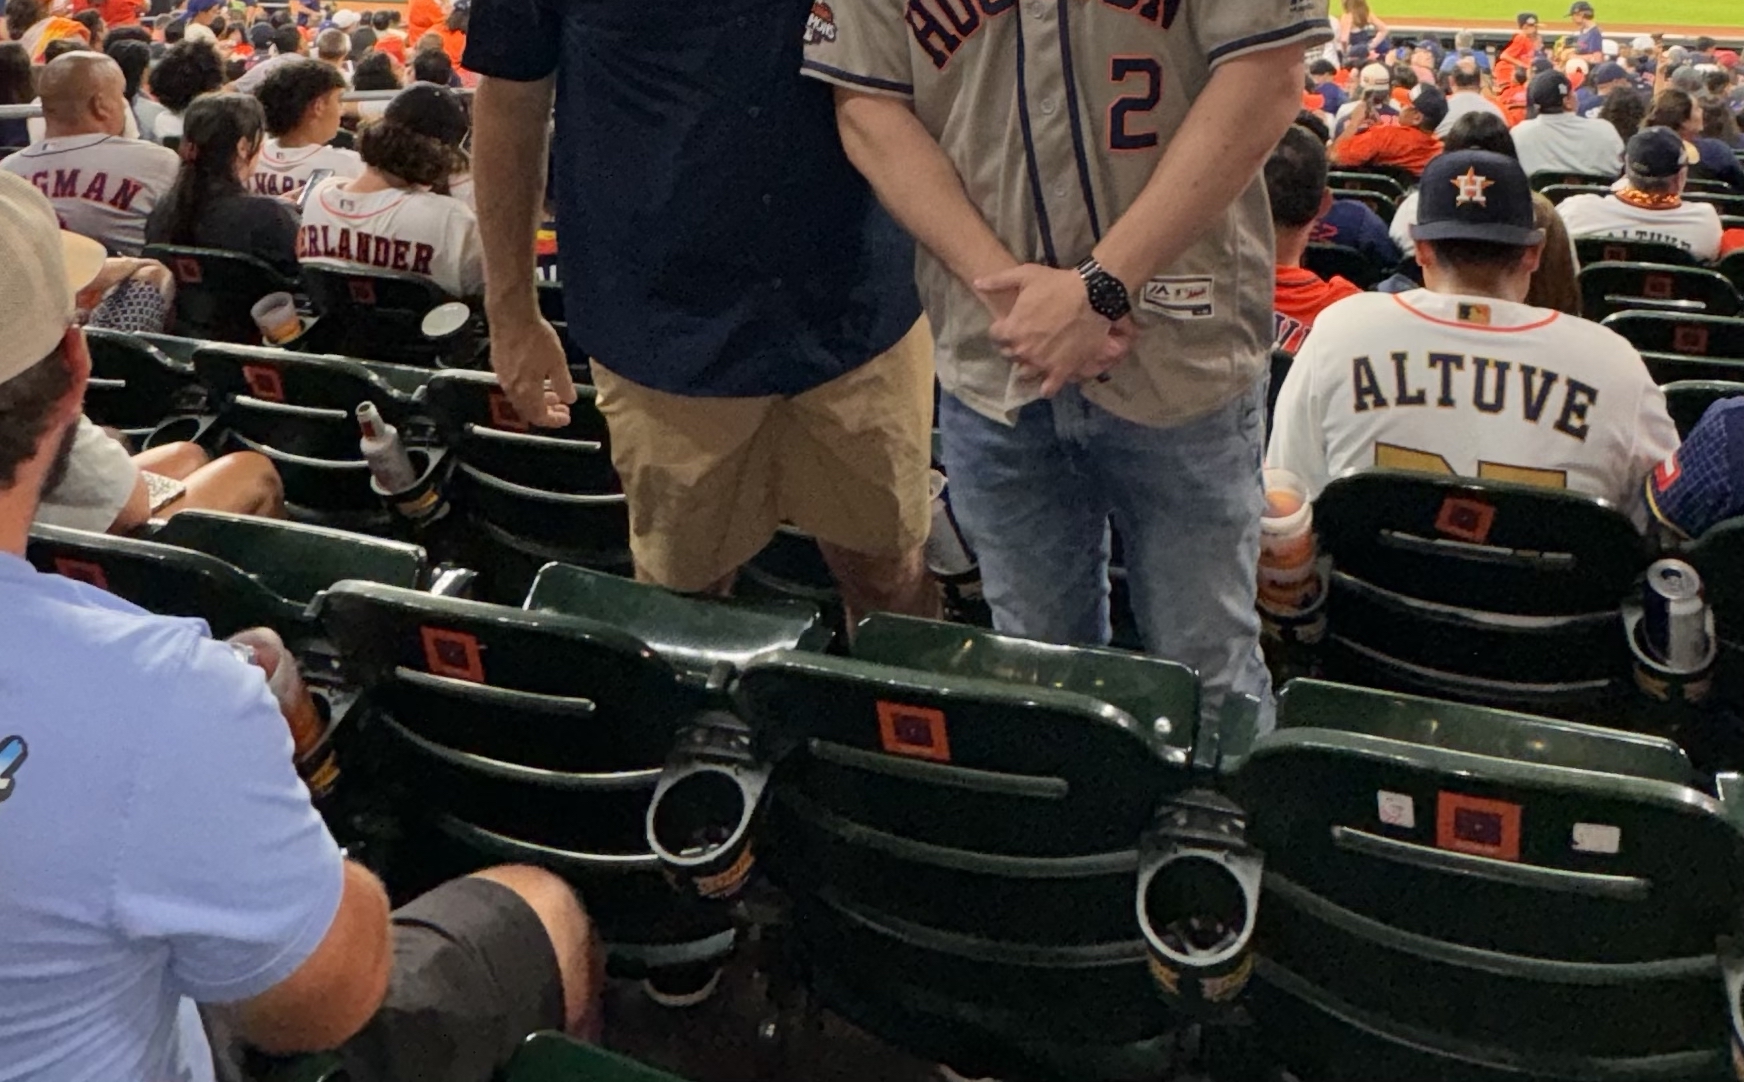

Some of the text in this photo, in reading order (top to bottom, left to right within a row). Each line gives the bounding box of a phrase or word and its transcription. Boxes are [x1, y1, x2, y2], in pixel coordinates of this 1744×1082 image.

[1108, 55, 1163, 150] 2
[22, 168, 143, 211] GMAN
[296, 224, 435, 276] ERLANDER
[1352, 350, 1599, 442] ALTUVE
